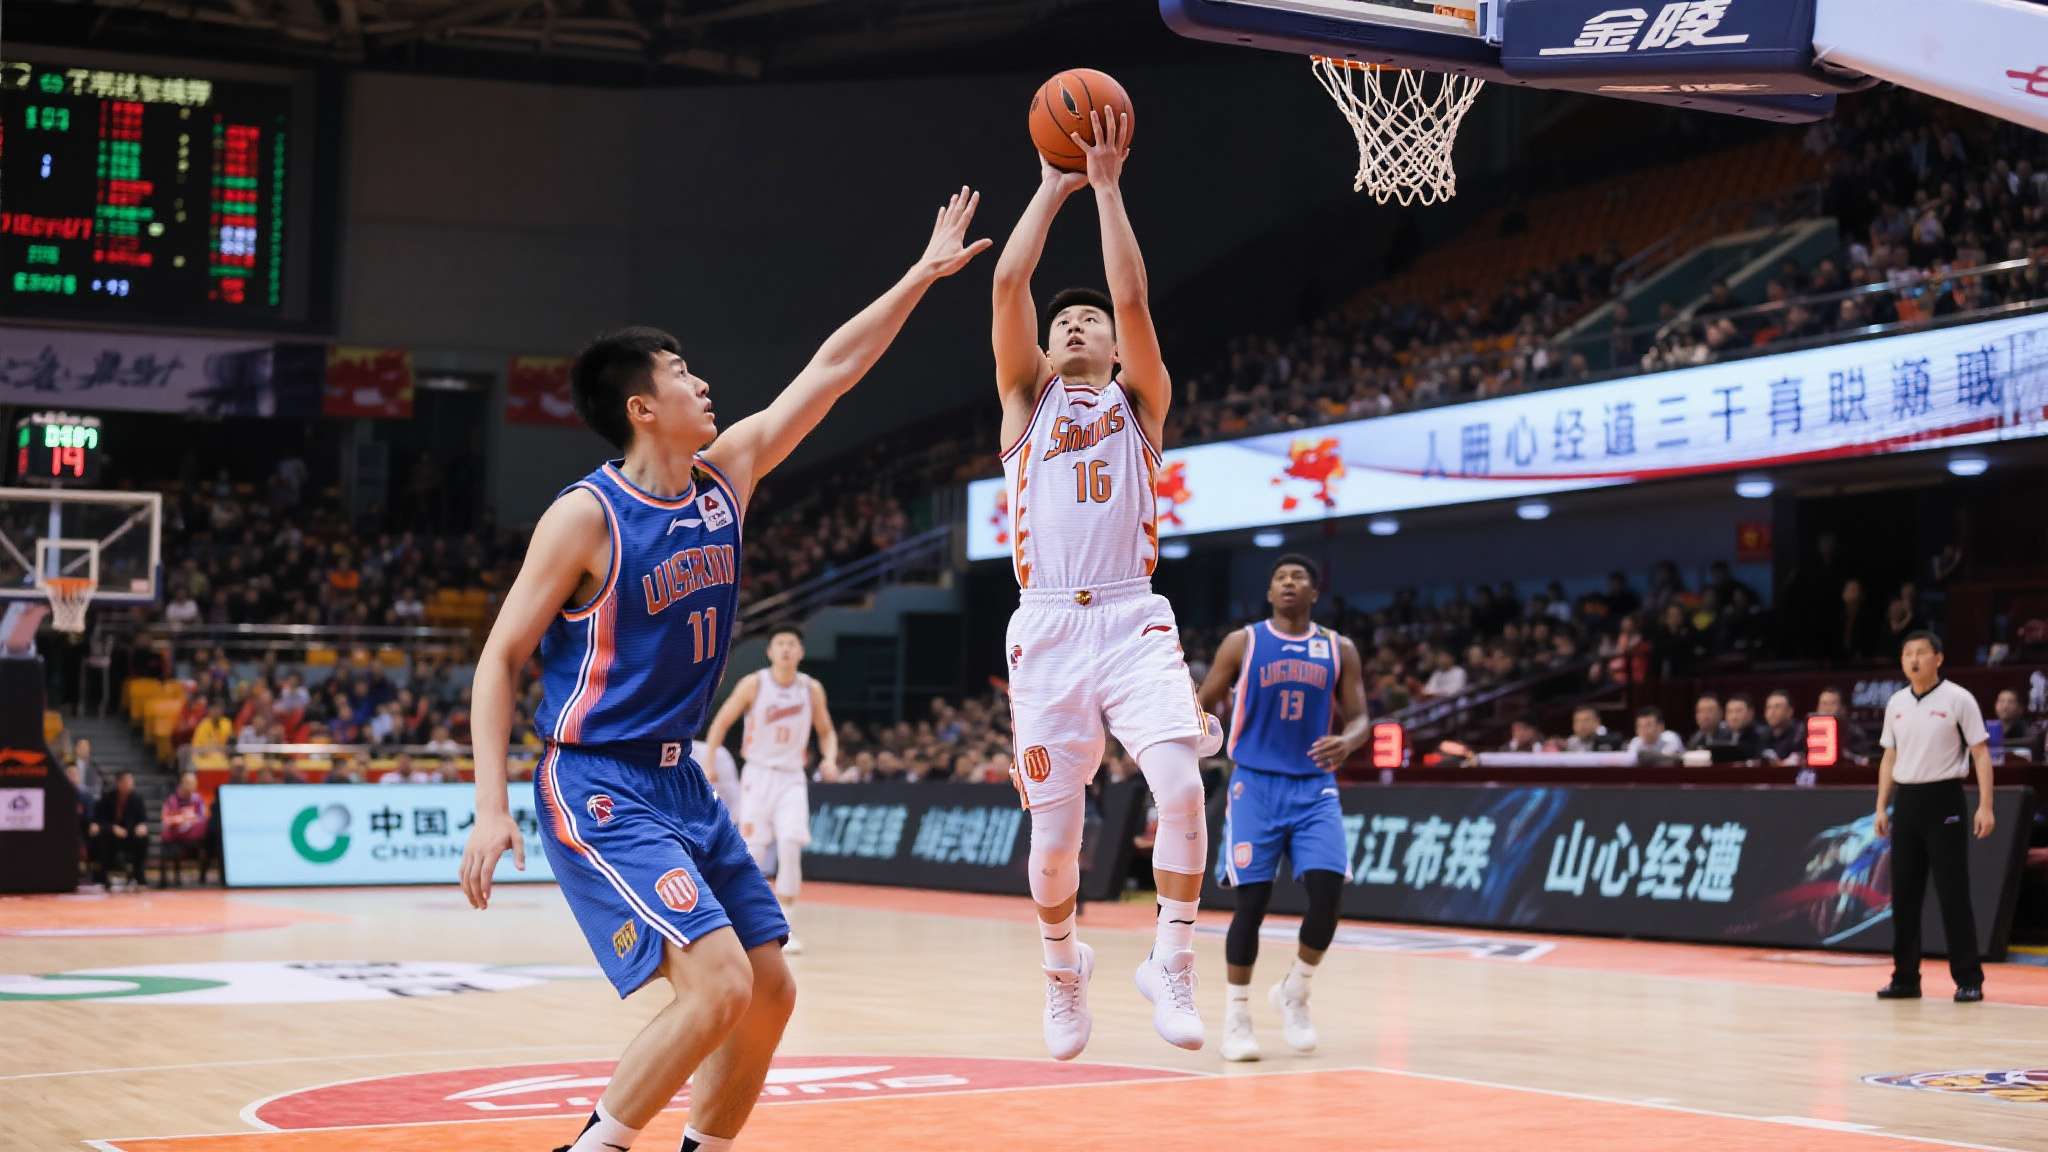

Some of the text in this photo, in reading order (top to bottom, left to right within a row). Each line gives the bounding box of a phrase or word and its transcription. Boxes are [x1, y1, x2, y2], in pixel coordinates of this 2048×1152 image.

[1072, 459, 1112, 503] 16
[688, 606, 717, 664] 11
[1280, 688, 1305, 721] 13
[1373, 723, 1402, 768] 3
[1807, 715, 1838, 766] 3
